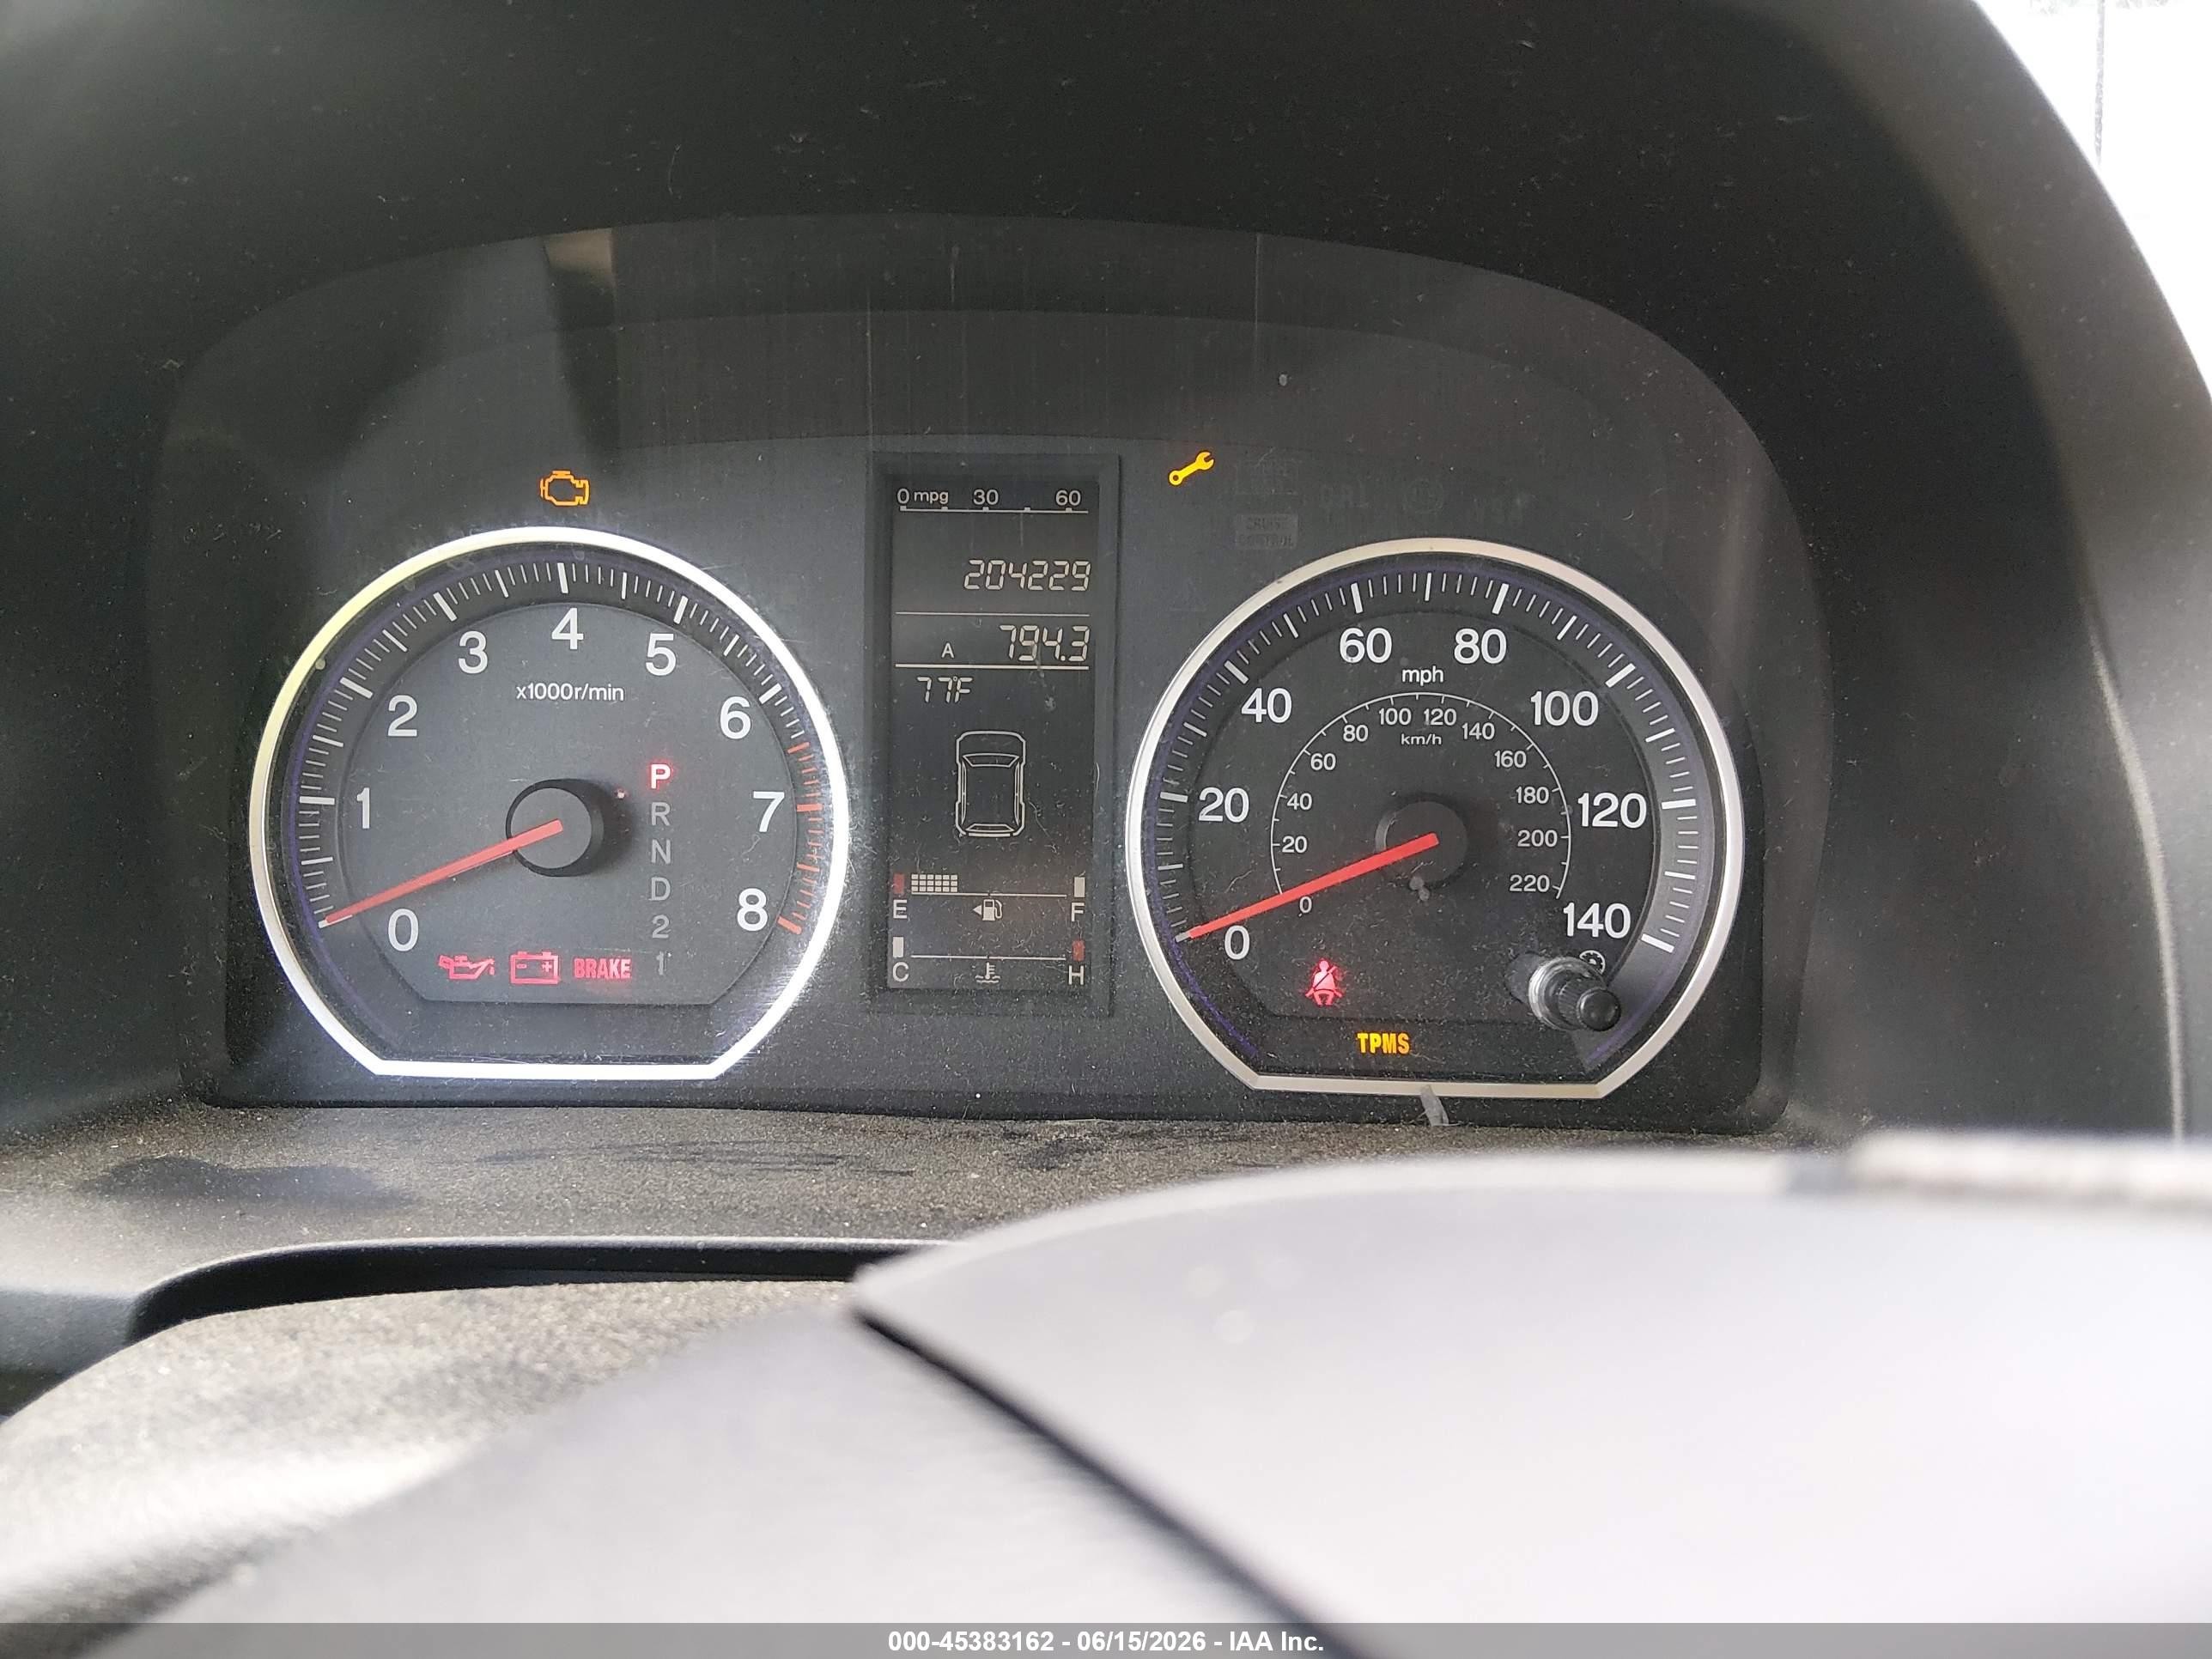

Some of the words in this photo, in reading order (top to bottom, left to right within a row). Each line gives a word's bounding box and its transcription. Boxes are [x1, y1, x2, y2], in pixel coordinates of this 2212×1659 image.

[897, 489, 909, 503] 0
[915, 492, 948, 504] mpg
[974, 489, 998, 505] 30
[1056, 490, 1080, 506] 60
[964, 560, 1091, 591] 204229
[552, 608, 583, 649] 4
[459, 631, 487, 673] 3
[646, 633, 676, 675] 5
[942, 643, 955, 658] A
[1000, 625, 1090, 661] 794.3
[1340, 628, 1392, 663] 60
[1455, 629, 1506, 664] 80
[1402, 666, 1443, 686] mph
[517, 683, 623, 701] x1000r/min
[388, 696, 417, 736] 2
[1242, 688, 1291, 722] 40
[1379, 708, 1411, 725] 100
[1531, 691, 1598, 726] 100
[720, 696, 750, 738] 6
[1424, 708, 1456, 726] 120
[1344, 725, 1368, 741] 80
[1401, 734, 1441, 744] km/h
[1462, 723, 1494, 739] 140
[1311, 753, 1335, 770] 60
[1495, 750, 1526, 768] 160
[652, 764, 671, 788] P
[1199, 787, 1249, 822] 20
[1287, 793, 1312, 810] 40
[1516, 787, 1549, 804] 180
[357, 787, 369, 829] 1
[652, 802, 670, 825] R
[754, 792, 784, 832] 7
[1578, 793, 1646, 828] 120
[1282, 836, 1307, 853] 20
[1518, 830, 1558, 847] 200
[652, 840, 671, 864] N
[651, 877, 670, 900] D
[1510, 875, 1549, 891] 220
[738, 889, 768, 931] 8
[893, 900, 907, 918] E
[1072, 902, 1085, 921] F
[1298, 896, 1311, 912] 0
[388, 909, 418, 951] 0
[653, 915, 671, 938] 2
[1564, 902, 1631, 938] 140
[1225, 925, 1249, 958] 0
[574, 958, 630, 980] BRAKE
[893, 962, 908, 981] C
[1069, 965, 1084, 985] H
[1358, 1033, 1409, 1054] TPMS
